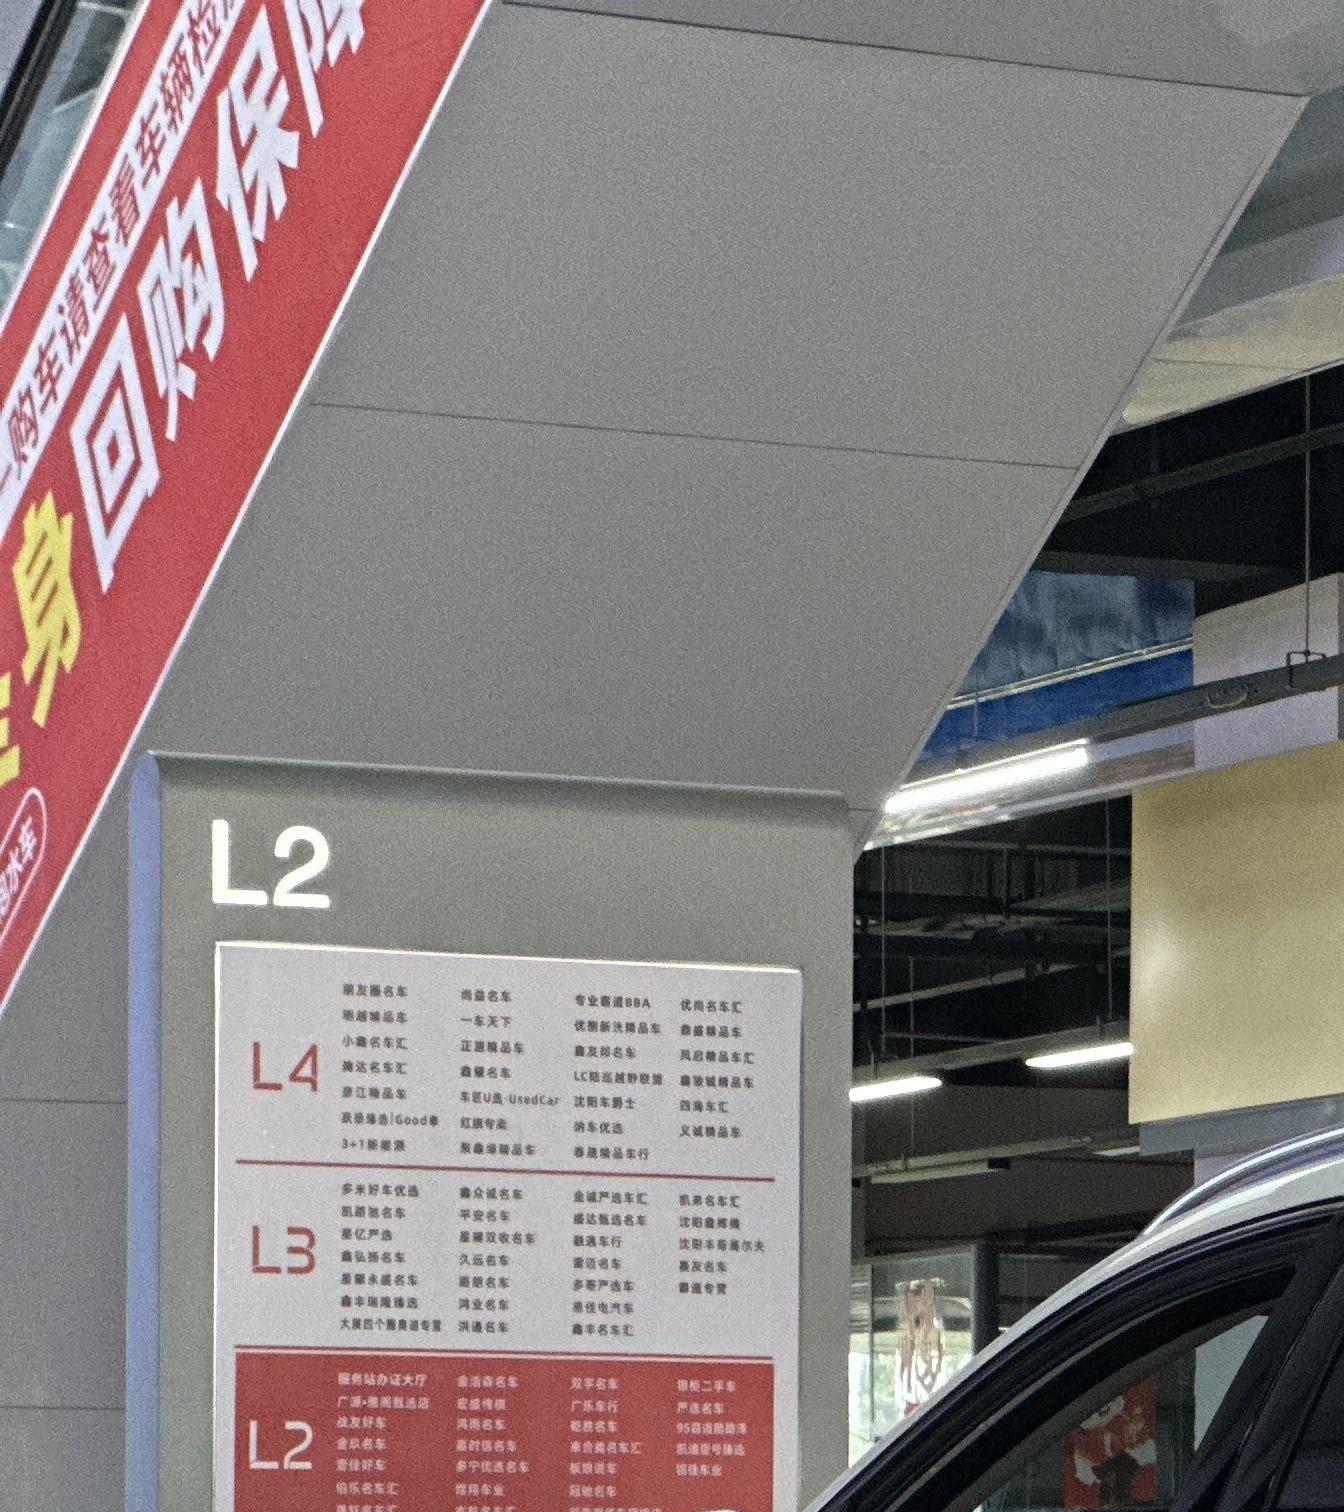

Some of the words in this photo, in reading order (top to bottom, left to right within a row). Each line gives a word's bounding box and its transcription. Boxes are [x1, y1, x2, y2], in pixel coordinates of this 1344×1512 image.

[212, 819, 331, 909] L2
[460, 1014, 512, 1029] 一车天下
[252, 1043, 319, 1092] L4
[251, 1227, 316, 1275] L3
[336, 1371, 429, 1388] 服务站办证大厅
[570, 1399, 619, 1414] 广乐车行
[249, 1420, 313, 1469] L2
